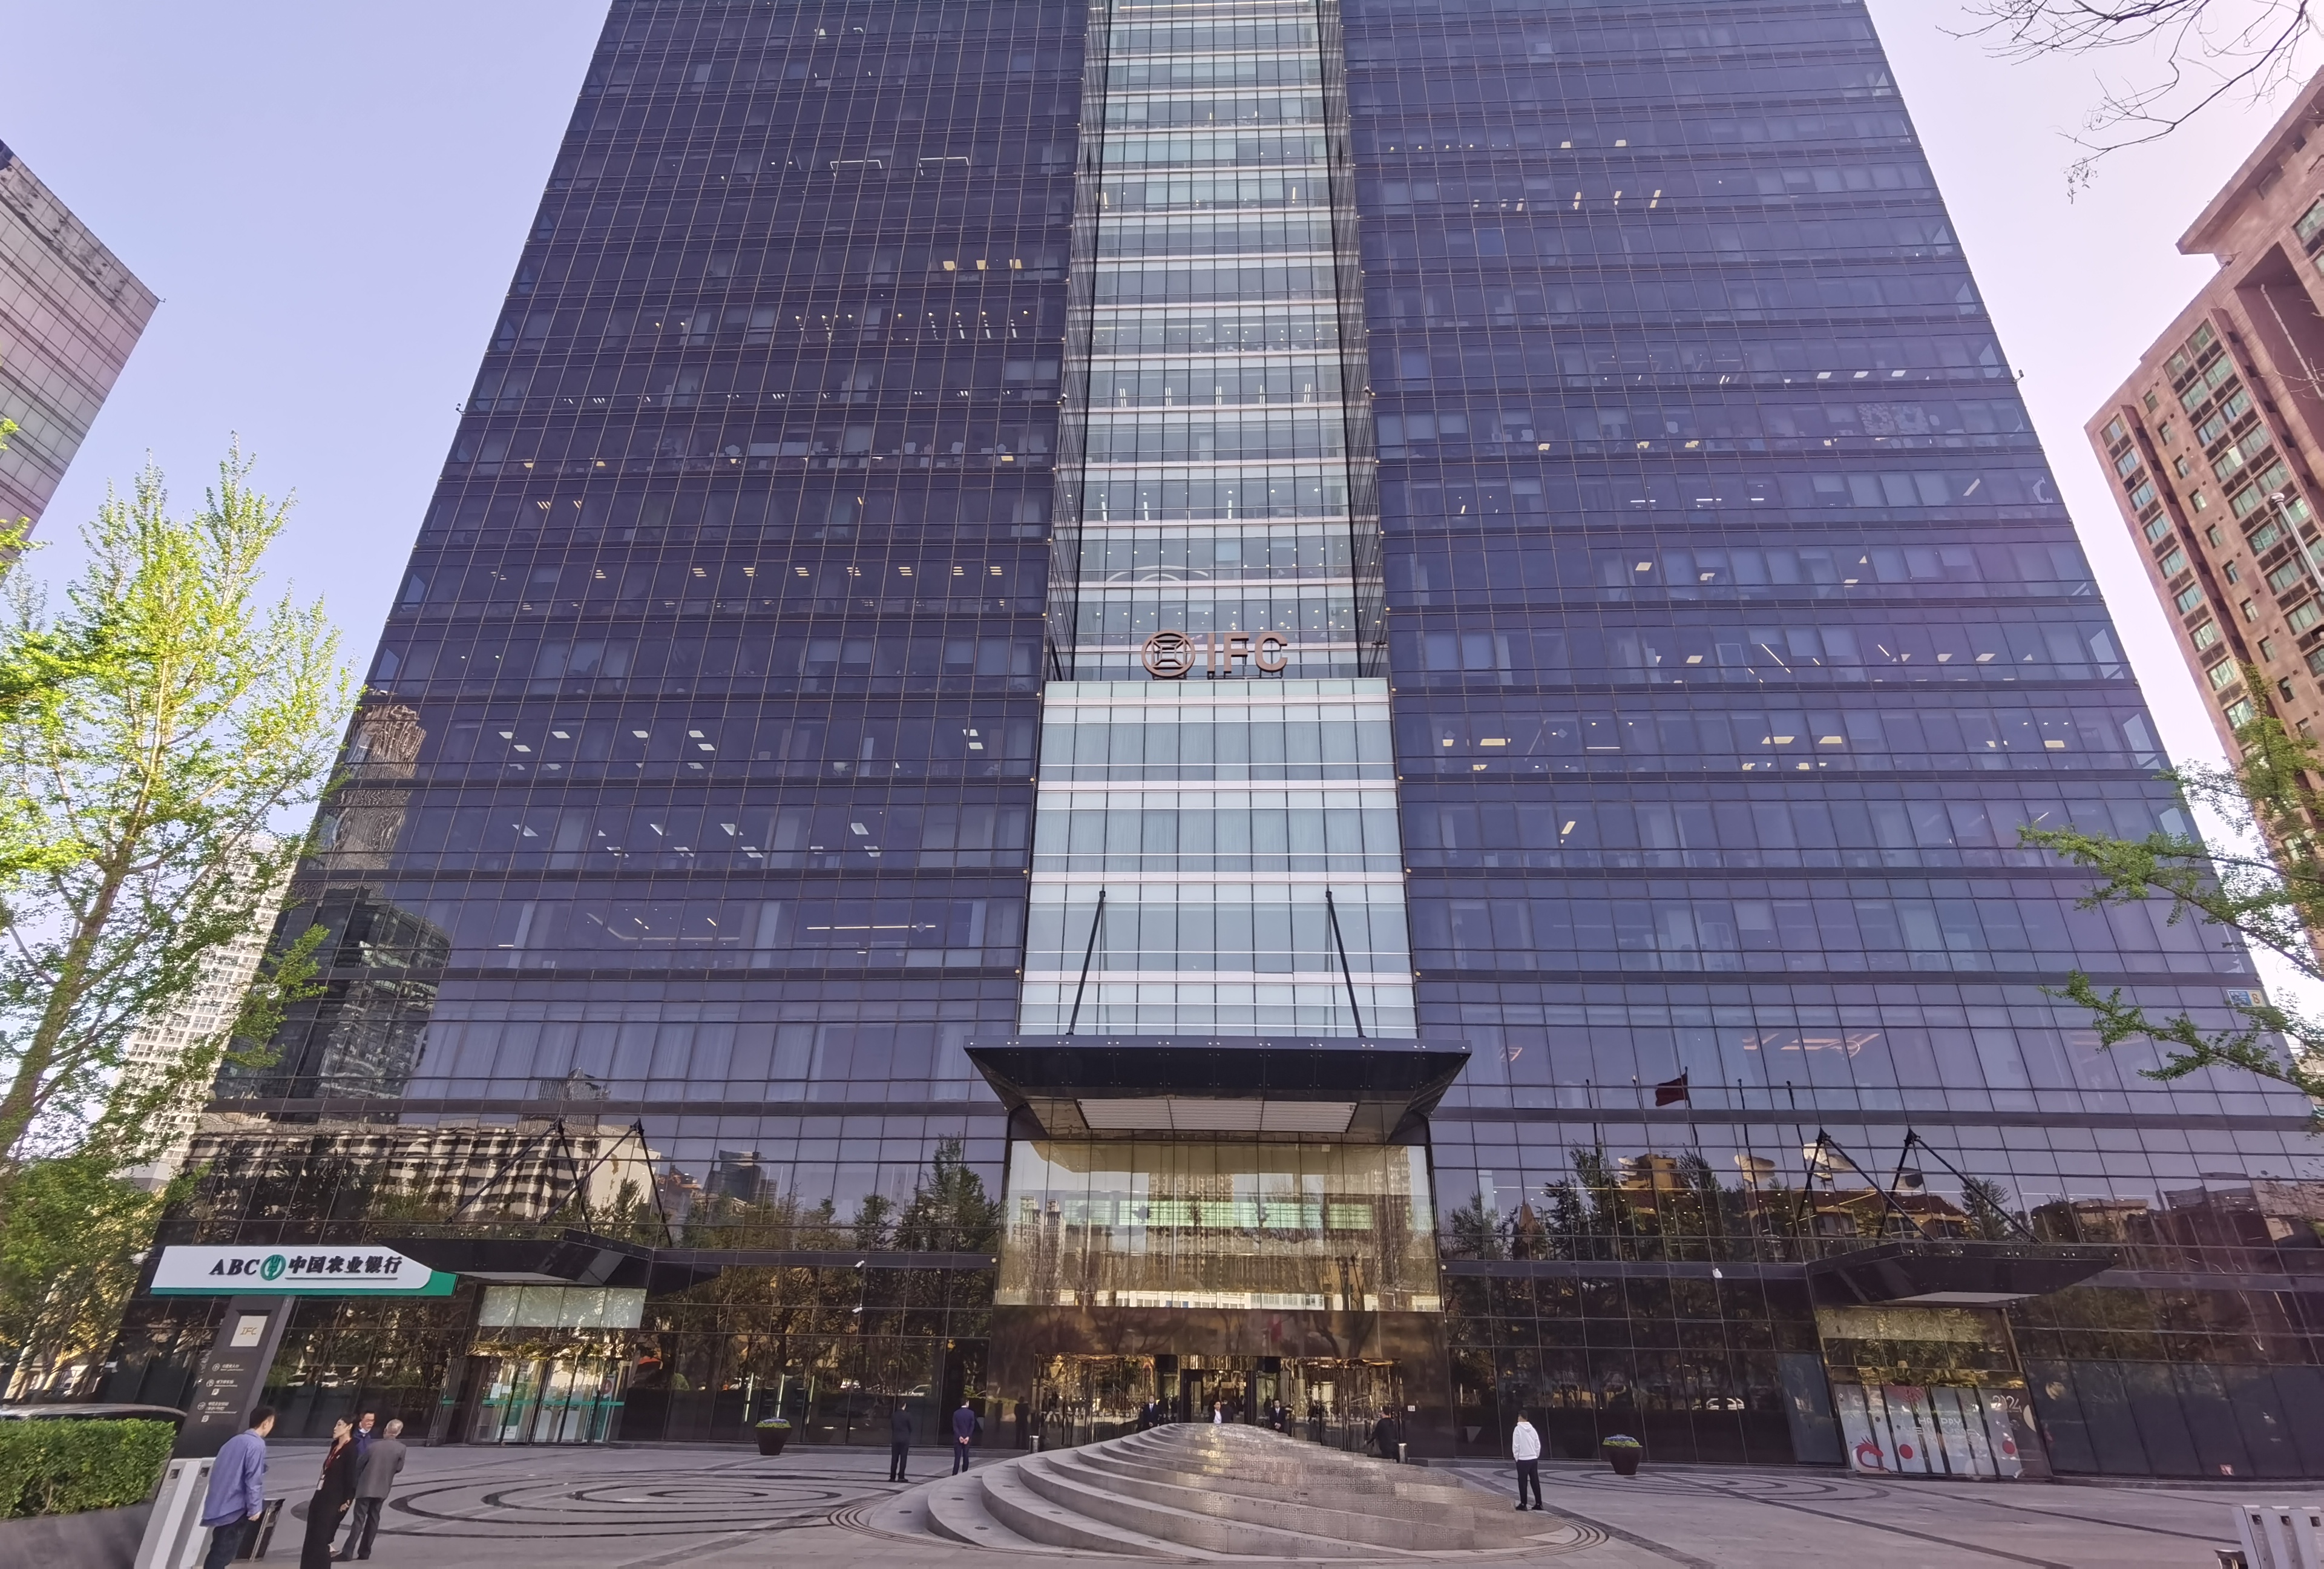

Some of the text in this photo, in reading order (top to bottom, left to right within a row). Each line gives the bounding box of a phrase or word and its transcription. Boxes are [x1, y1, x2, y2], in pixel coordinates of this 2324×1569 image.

[1207, 631, 1288, 674] IFC
[208, 1258, 260, 1275] ABC
[287, 1255, 402, 1274] 中国农业银行
[240, 1326, 258, 1336] IFC
